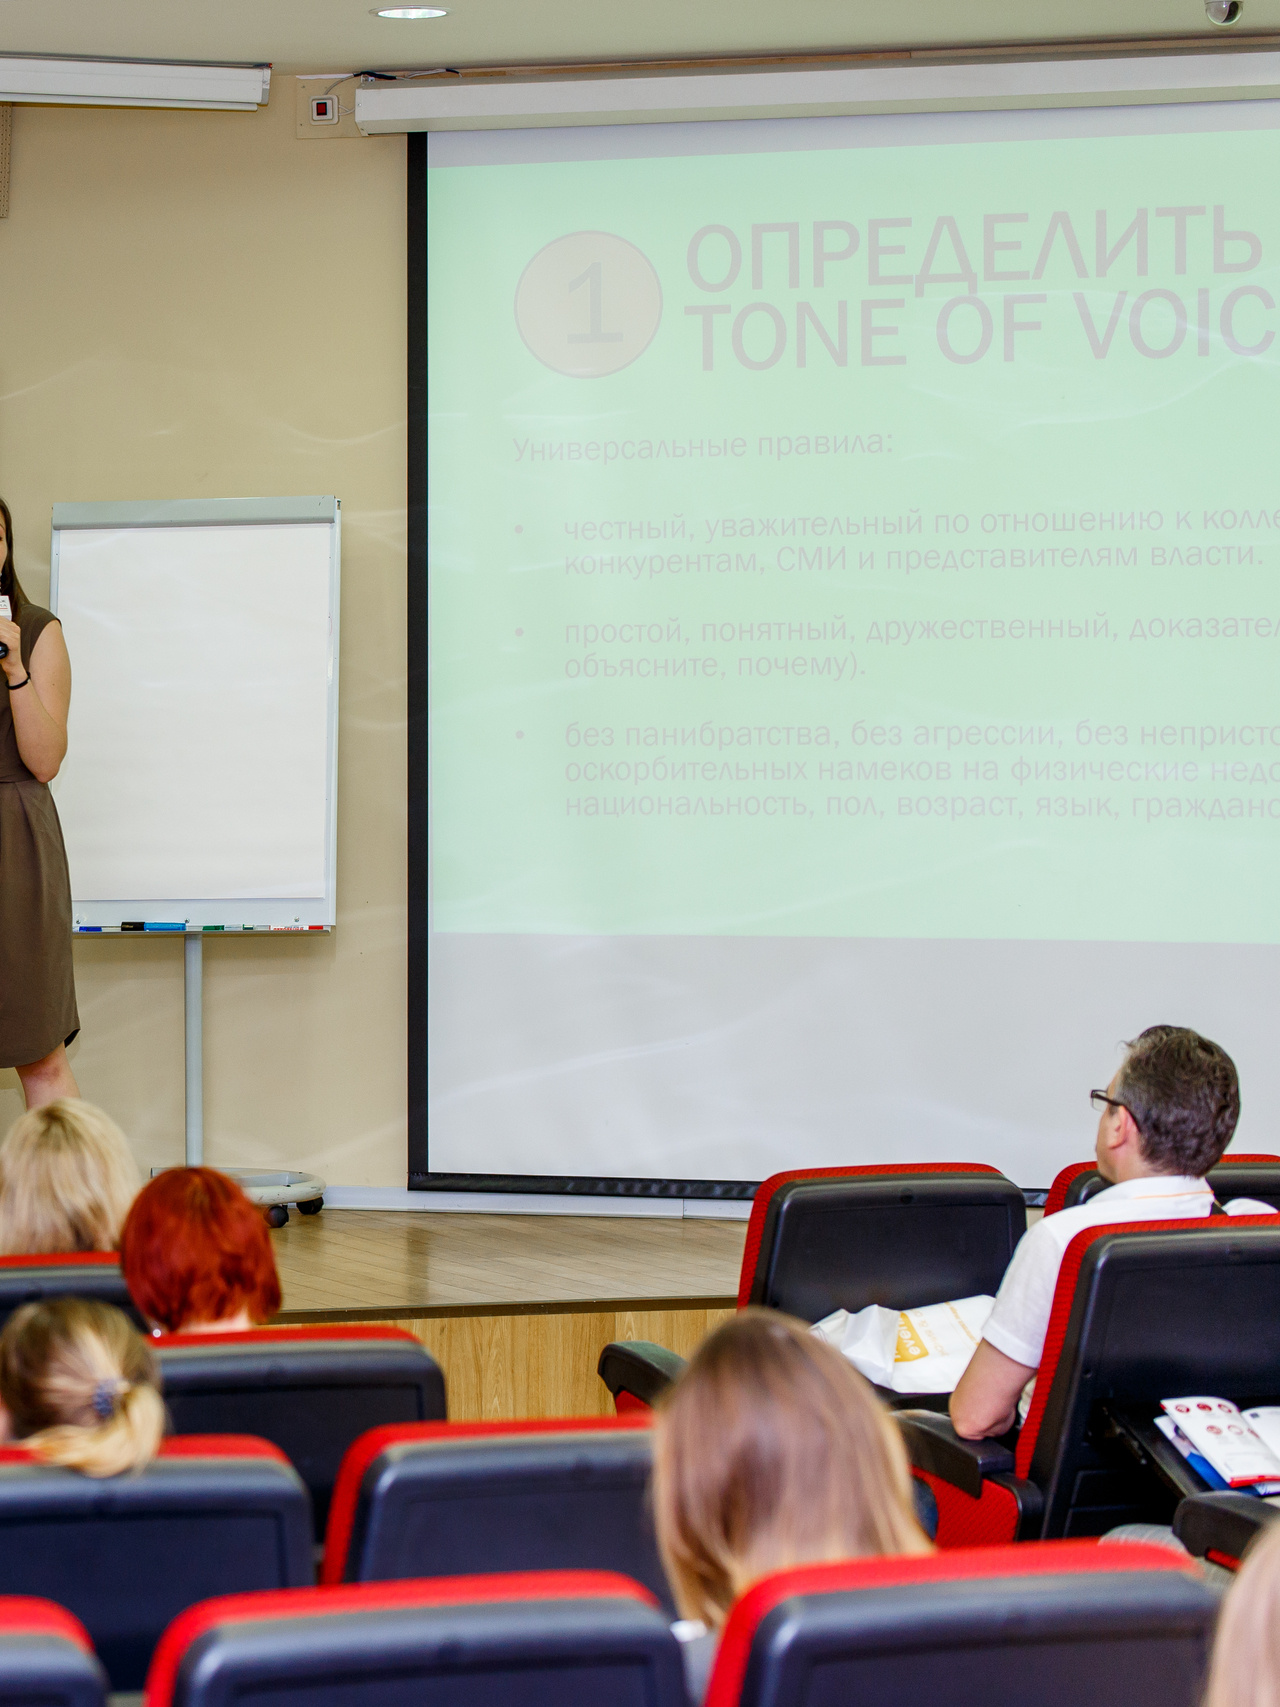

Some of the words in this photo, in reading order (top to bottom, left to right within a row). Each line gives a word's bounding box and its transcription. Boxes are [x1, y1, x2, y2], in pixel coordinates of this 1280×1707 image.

[686, 204, 1263, 298] ОПРЕДЕЛИТЬ
[568, 263, 623, 343] 1
[684, 297, 908, 373] TONE
[935, 292, 1048, 366] OF
[1072, 285, 1277, 361] VOIC
[512, 437, 747, 465] Универсальные
[759, 434, 892, 461] правила:
[564, 513, 694, 540] честный,
[705, 508, 922, 544] уважительный
[935, 514, 969, 534] по
[981, 510, 1163, 533] отношению
[1176, 511, 1192, 529] к
[565, 553, 765, 580] конкурентам,
[777, 546, 846, 571] СМИ
[859, 552, 874, 569] и
[887, 547, 1137, 575] представителям
[1151, 546, 1263, 566] власти.
[566, 617, 690, 648] простой,
[702, 615, 855, 642] понятный,
[866, 612, 1118, 646] дружественный,
[565, 653, 726, 679] объясните,
[738, 652, 865, 681] почему).
[565, 721, 614, 747] без
[626, 720, 839, 751] панибратства,
[851, 720, 902, 746] без
[914, 725, 1062, 750] агрессии,
[1076, 719, 1128, 745] без
[565, 756, 807, 785] оскорбительных
[819, 761, 951, 781] намеков
[964, 761, 998, 780] на
[1011, 756, 1198, 786] физические
[566, 796, 814, 818] национальность,
[827, 796, 884, 818] пол,
[898, 796, 1023, 821] возраст,
[1036, 797, 1119, 820] язык,
